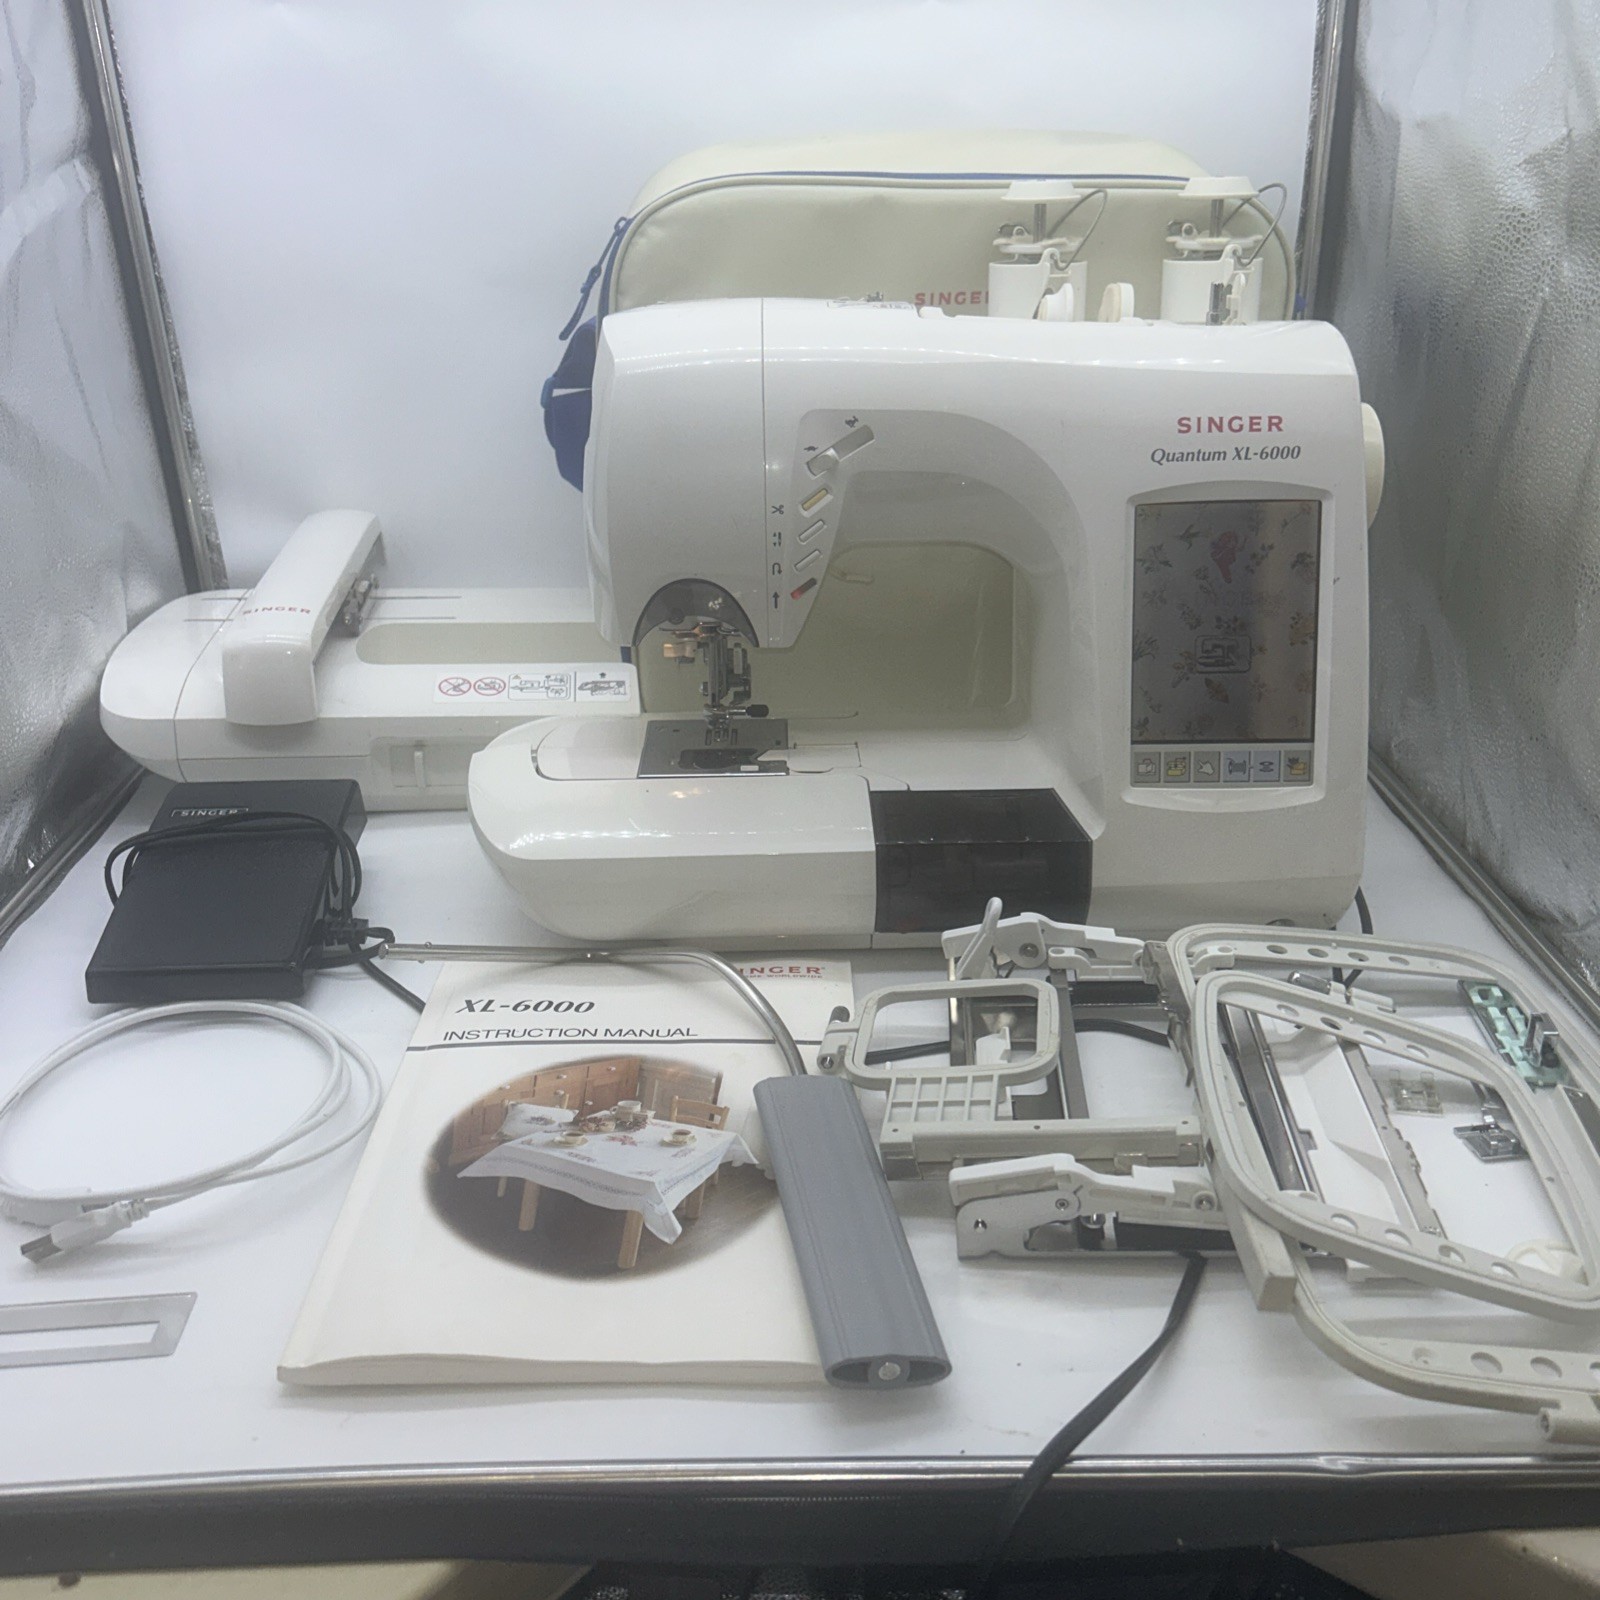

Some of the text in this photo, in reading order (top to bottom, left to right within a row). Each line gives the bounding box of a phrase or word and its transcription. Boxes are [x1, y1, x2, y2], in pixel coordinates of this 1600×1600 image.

[1177, 415, 1284, 434] SINGER
[1151, 445, 1301, 466] Quantum XL-6000
[242, 606, 311, 616] SINGER
[180, 809, 238, 817] SINGER
[739, 966, 821, 975] INGER
[455, 999, 595, 1014] XL-6000
[443, 1028, 699, 1041] INSTRUCTION MANUAL
